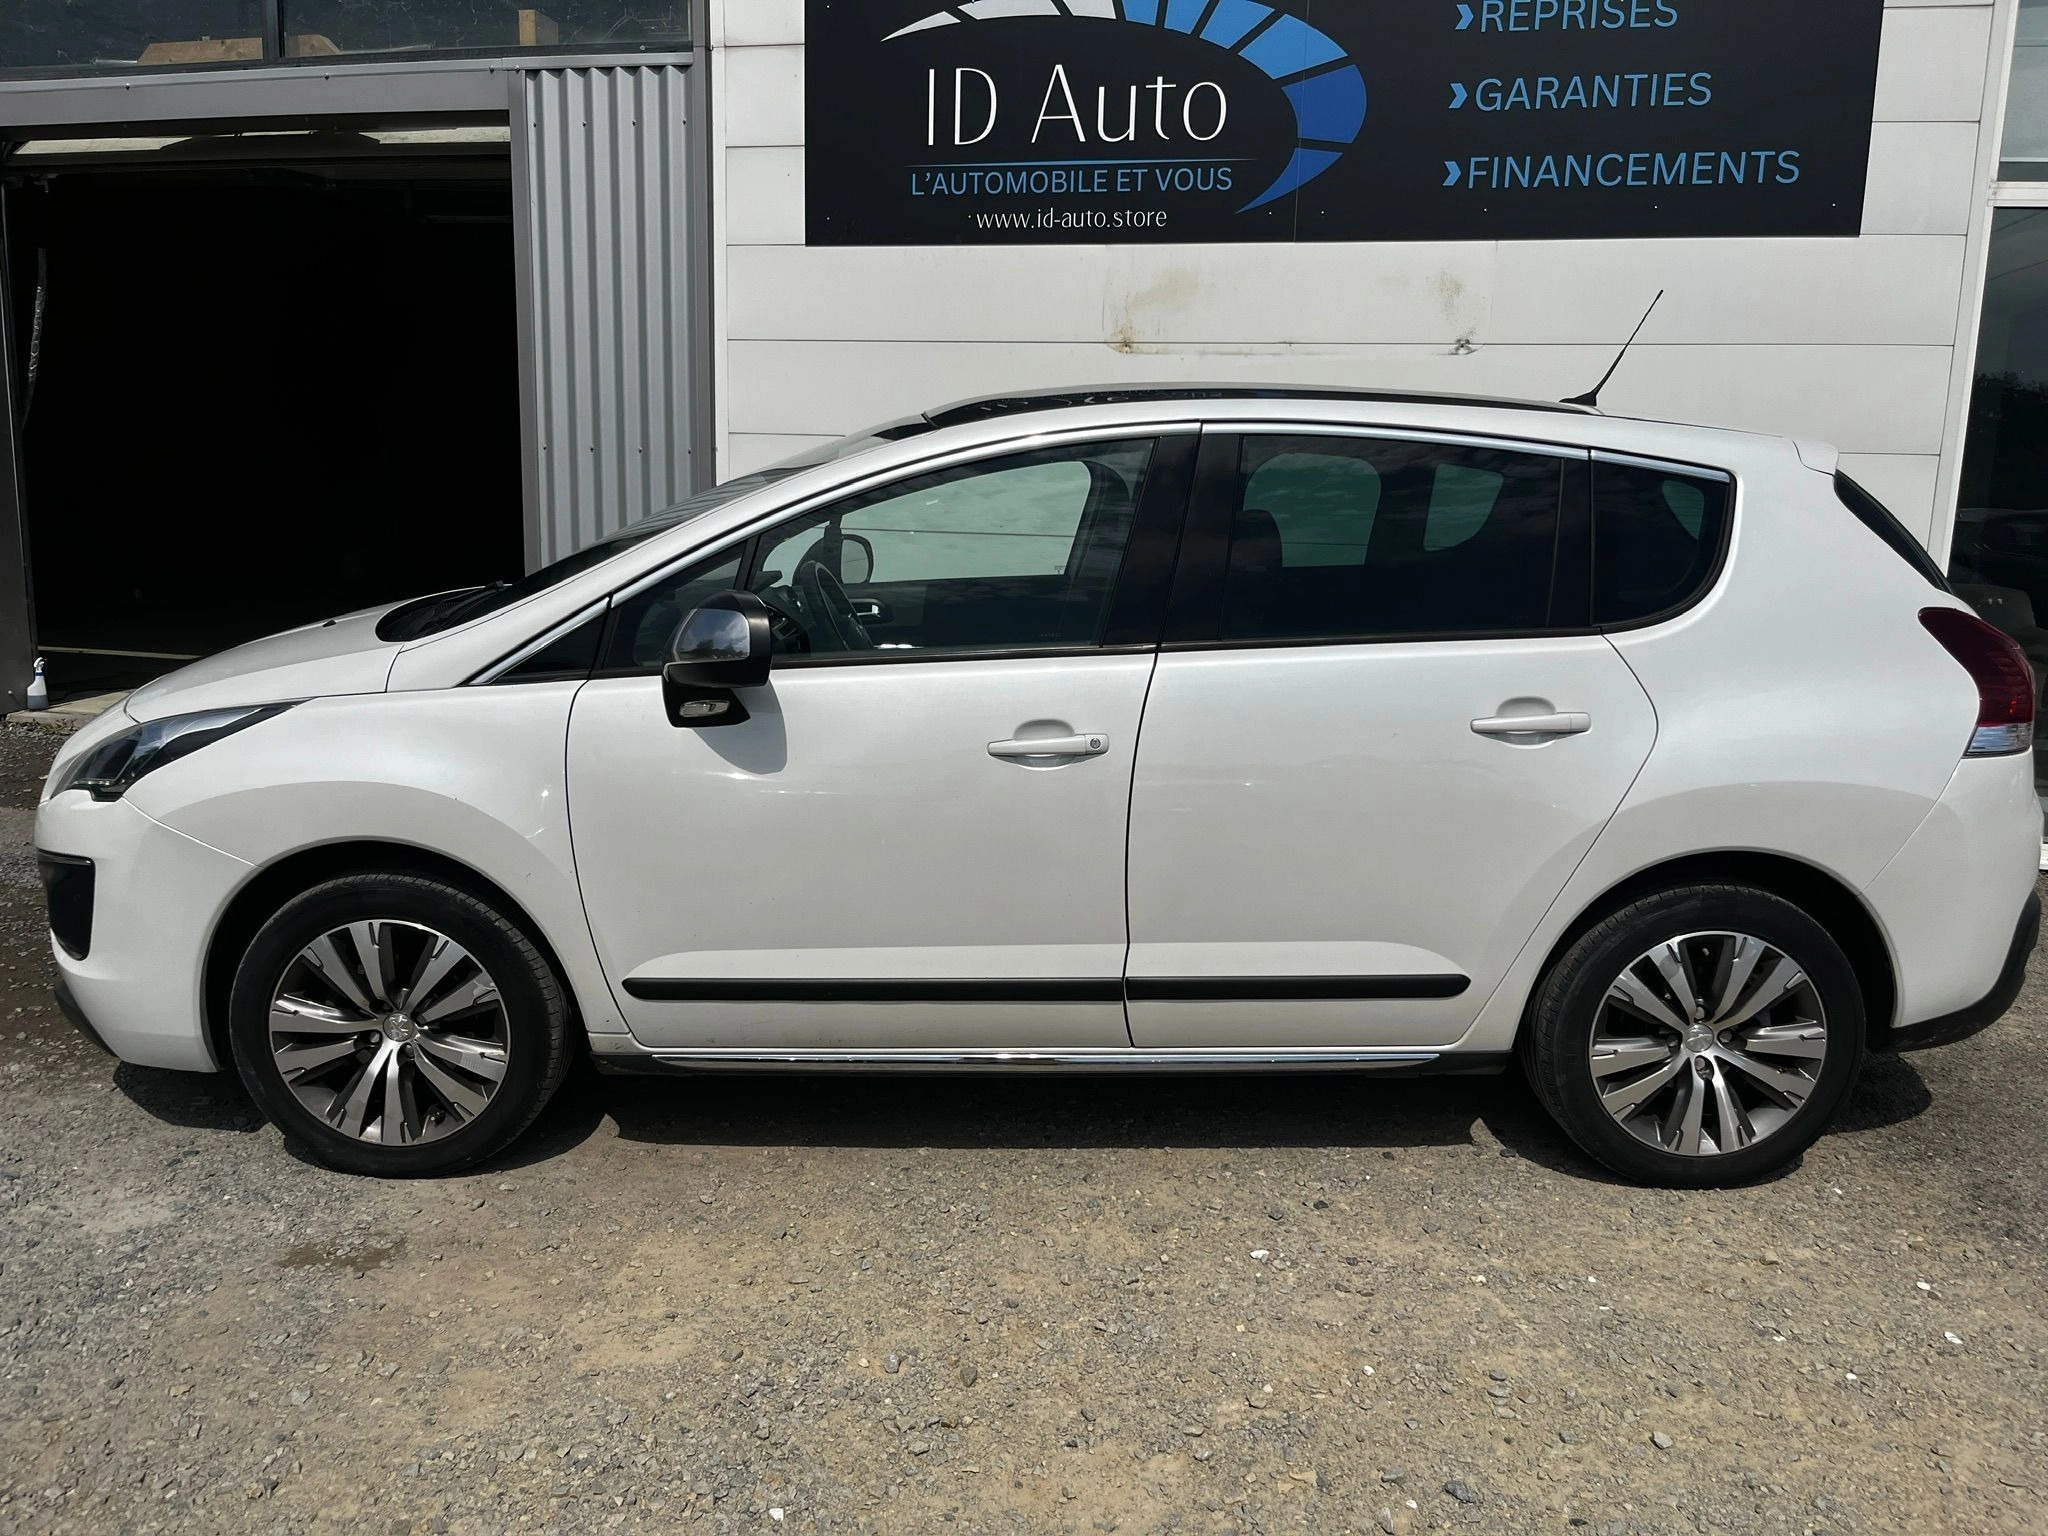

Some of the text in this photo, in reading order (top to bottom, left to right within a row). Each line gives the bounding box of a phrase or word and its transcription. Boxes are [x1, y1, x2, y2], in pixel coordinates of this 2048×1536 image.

[1480, 0, 1678, 33] REPRISES
[927, 63, 1227, 146] ID Auto
[1475, 72, 1712, 112] GARANTIES
[911, 167, 1233, 196] L'AUTOMOBILE ET VOUS
[1467, 150, 1800, 189] FINANCEMENTS
[976, 207, 1167, 229] www.id-auto.store
